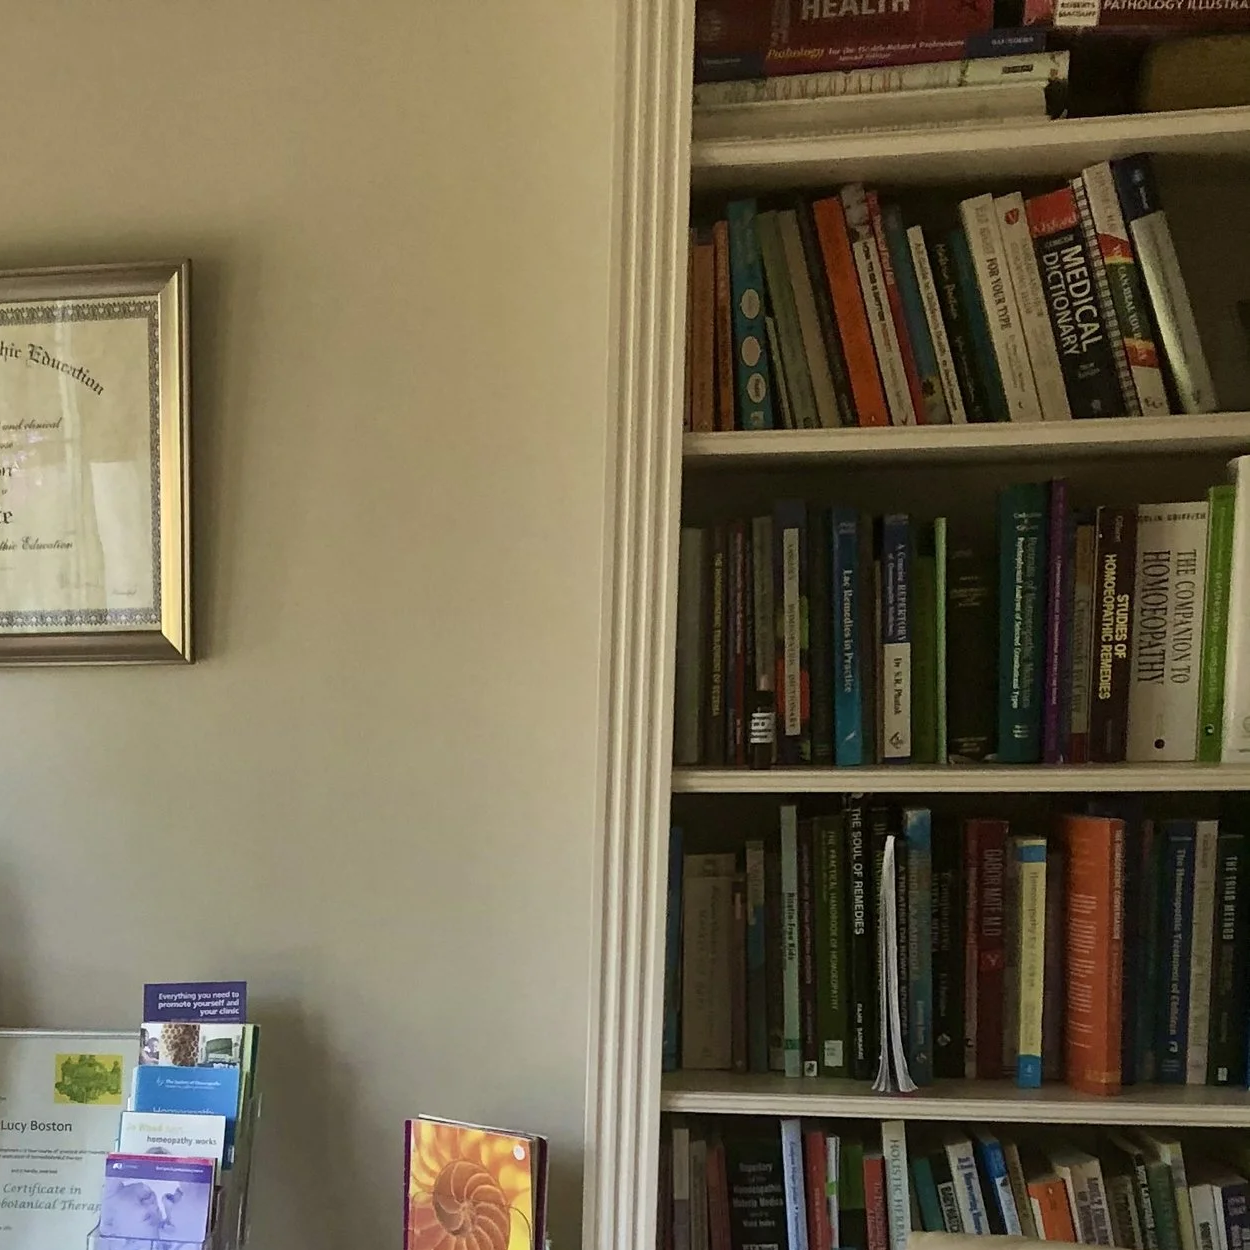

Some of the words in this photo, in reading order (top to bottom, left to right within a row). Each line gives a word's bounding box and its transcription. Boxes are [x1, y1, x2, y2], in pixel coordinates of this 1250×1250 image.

[1041, 250, 1080, 359] DICTIONARY
[1058, 244, 1105, 354] MEDICAL
[996, 305, 1012, 331] TYPE
[27, 342, 106, 396] Education
[2, 418, 25, 431] and
[21, 536, 74, 551] Education
[1175, 548, 1197, 577] THE
[841, 569, 853, 587] Lac
[895, 584, 907, 641] REPERTORY
[1099, 553, 1117, 643] HOMOEOPATHIC
[842, 589, 854, 638] Remedies
[1113, 593, 1129, 641] STUDIES
[1135, 548, 1171, 686] HOMOEOPATHY
[1171, 580, 1196, 662] COMPANION
[843, 639, 853, 650] in
[1113, 643, 1127, 660] OF
[843, 652, 853, 693] Practice
[1097, 643, 1113, 701] REMEDIES
[1170, 664, 1191, 685] TO
[850, 806, 863, 828] THE
[851, 830, 864, 861] SOUL
[826, 848, 838, 891] PRACTICAL
[852, 861, 864, 878] OF
[983, 849, 1003, 886] GABOR
[1224, 855, 1238, 873] THE
[827, 892, 839, 937] HANDBOOK
[851, 880, 866, 935] REMEDIES
[1220, 904, 1236, 941] METHOD
[829, 938, 838, 948] OF
[158, 992, 197, 1001] Everything
[197, 993, 211, 1001] you
[212, 991, 230, 999] need
[1169, 982, 1181, 994] of
[157, 1001, 191, 1010] promote
[193, 999, 225, 1009] yourself
[199, 1009, 218, 1017] your
[218, 1007, 240, 1015] clinic
[0, 1119, 27, 1134] Lucy
[30, 1120, 73, 1132] Boston
[146, 1135, 193, 1145] homeopathy
[887, 1138, 906, 1197] HOLISTIC
[2, 1182, 67, 1197] Certificate
[69, 1184, 82, 1195] in
